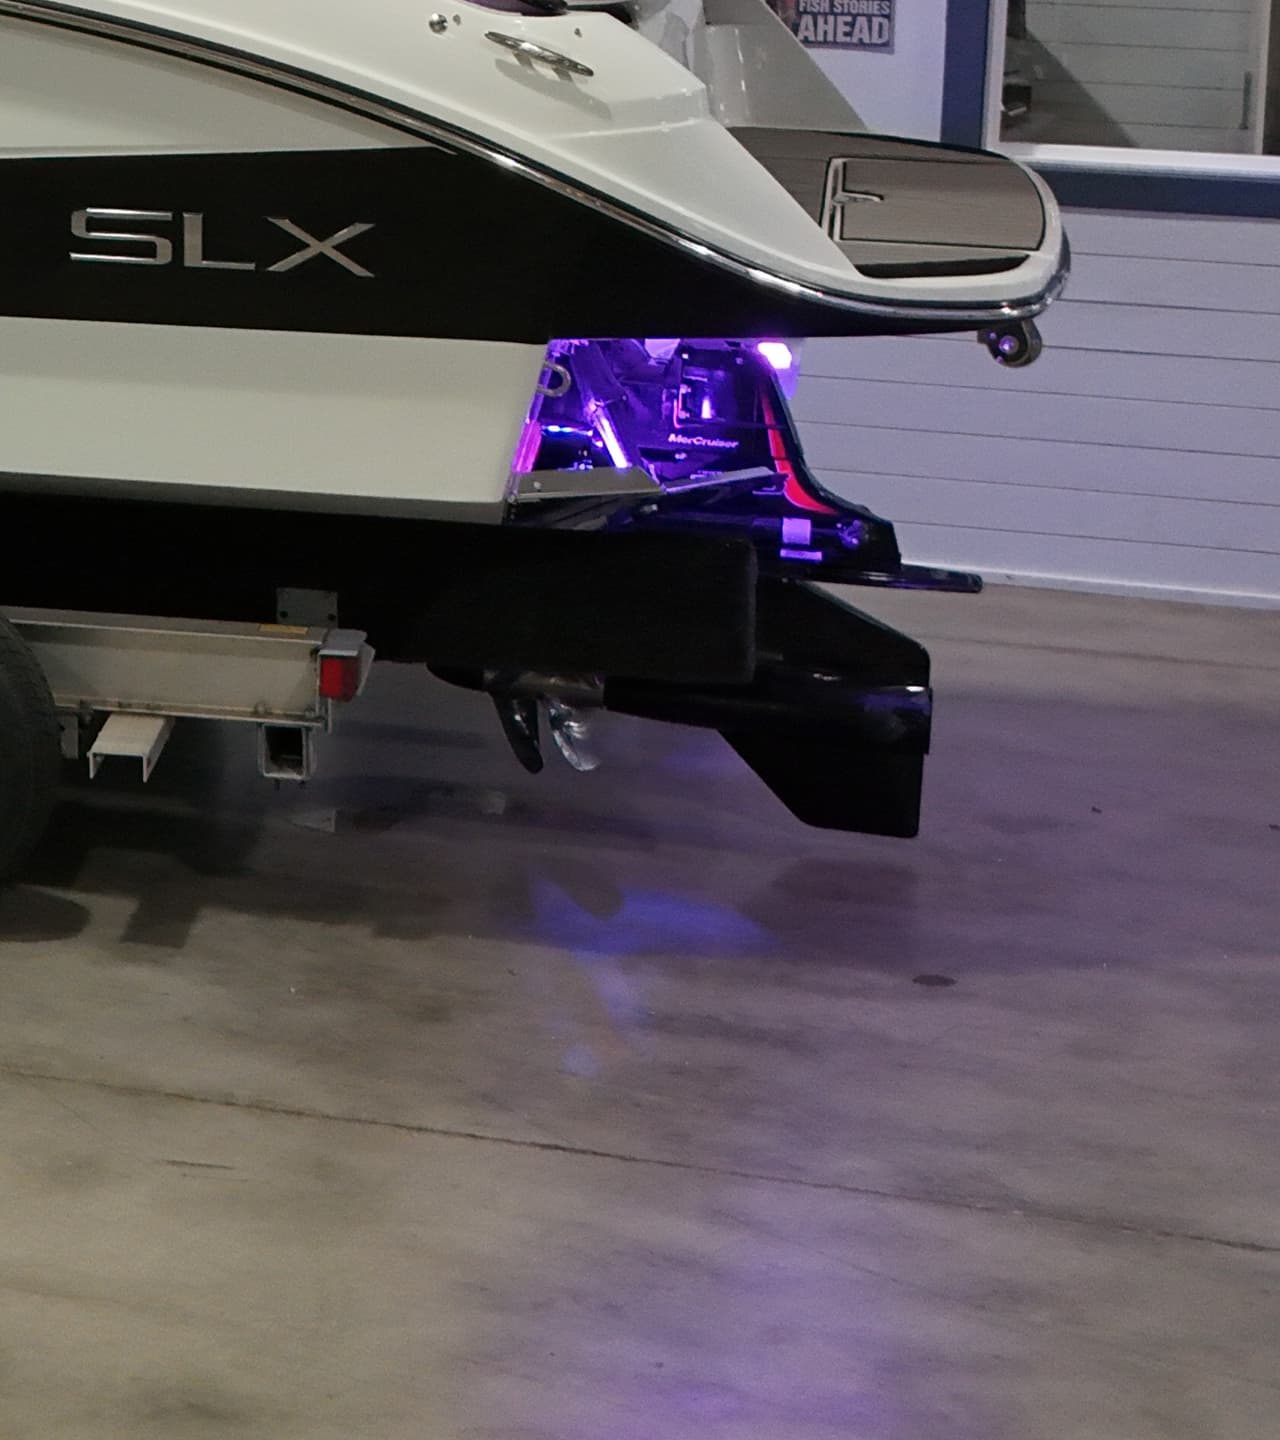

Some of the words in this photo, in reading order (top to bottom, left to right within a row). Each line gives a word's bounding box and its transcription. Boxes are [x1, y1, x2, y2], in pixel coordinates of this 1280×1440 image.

[833, 0, 890, 15] STORIES
[797, 14, 889, 44] AHEAD
[69, 207, 376, 278] SLX
[668, 433, 739, 448] MerCruiser
